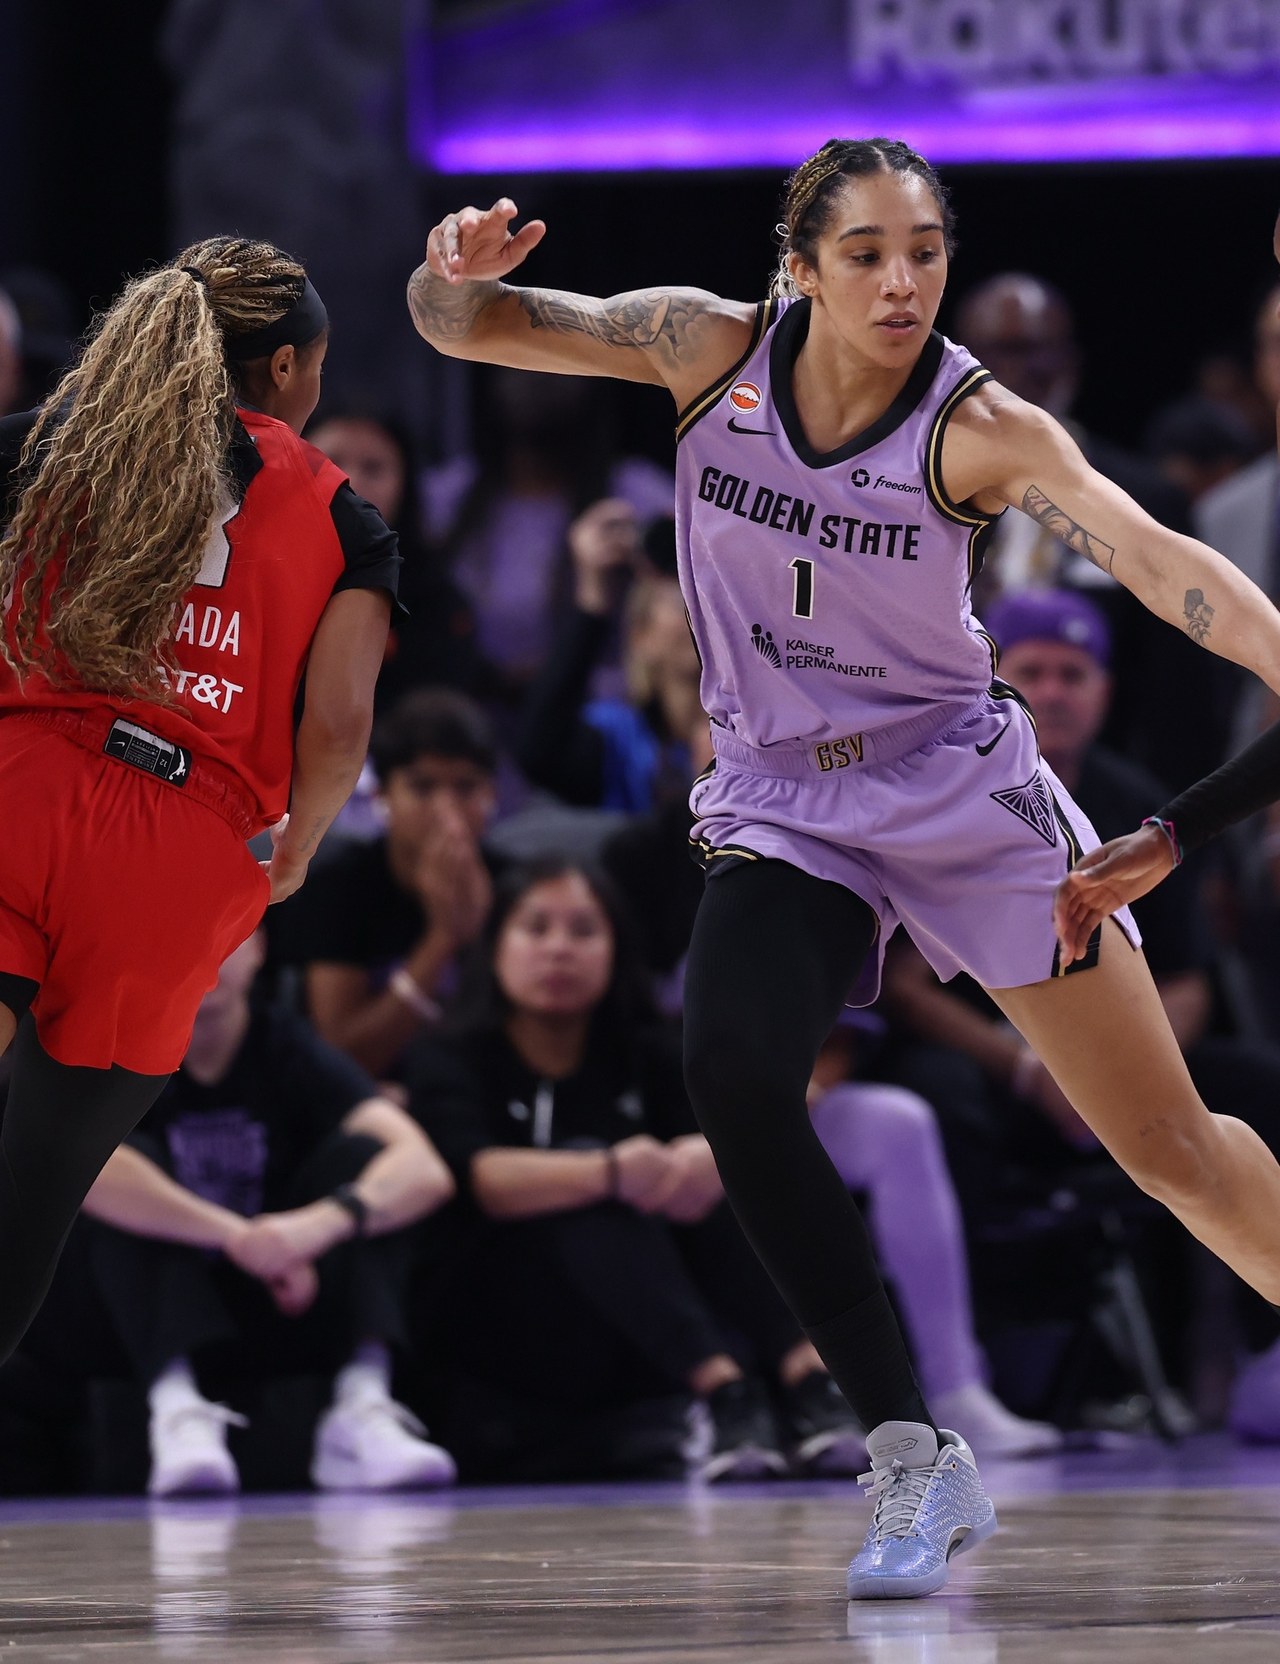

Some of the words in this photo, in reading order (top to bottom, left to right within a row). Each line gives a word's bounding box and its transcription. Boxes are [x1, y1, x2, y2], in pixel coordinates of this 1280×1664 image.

[873, 475, 922, 494] freedom
[698, 466, 815, 536] GOLDEN
[819, 515, 921, 561] STATE
[787, 556, 815, 620] 1
[786, 639, 835, 658] KAISER
[786, 655, 887, 678] PERMANENTE
[814, 732, 864, 772] GSV
